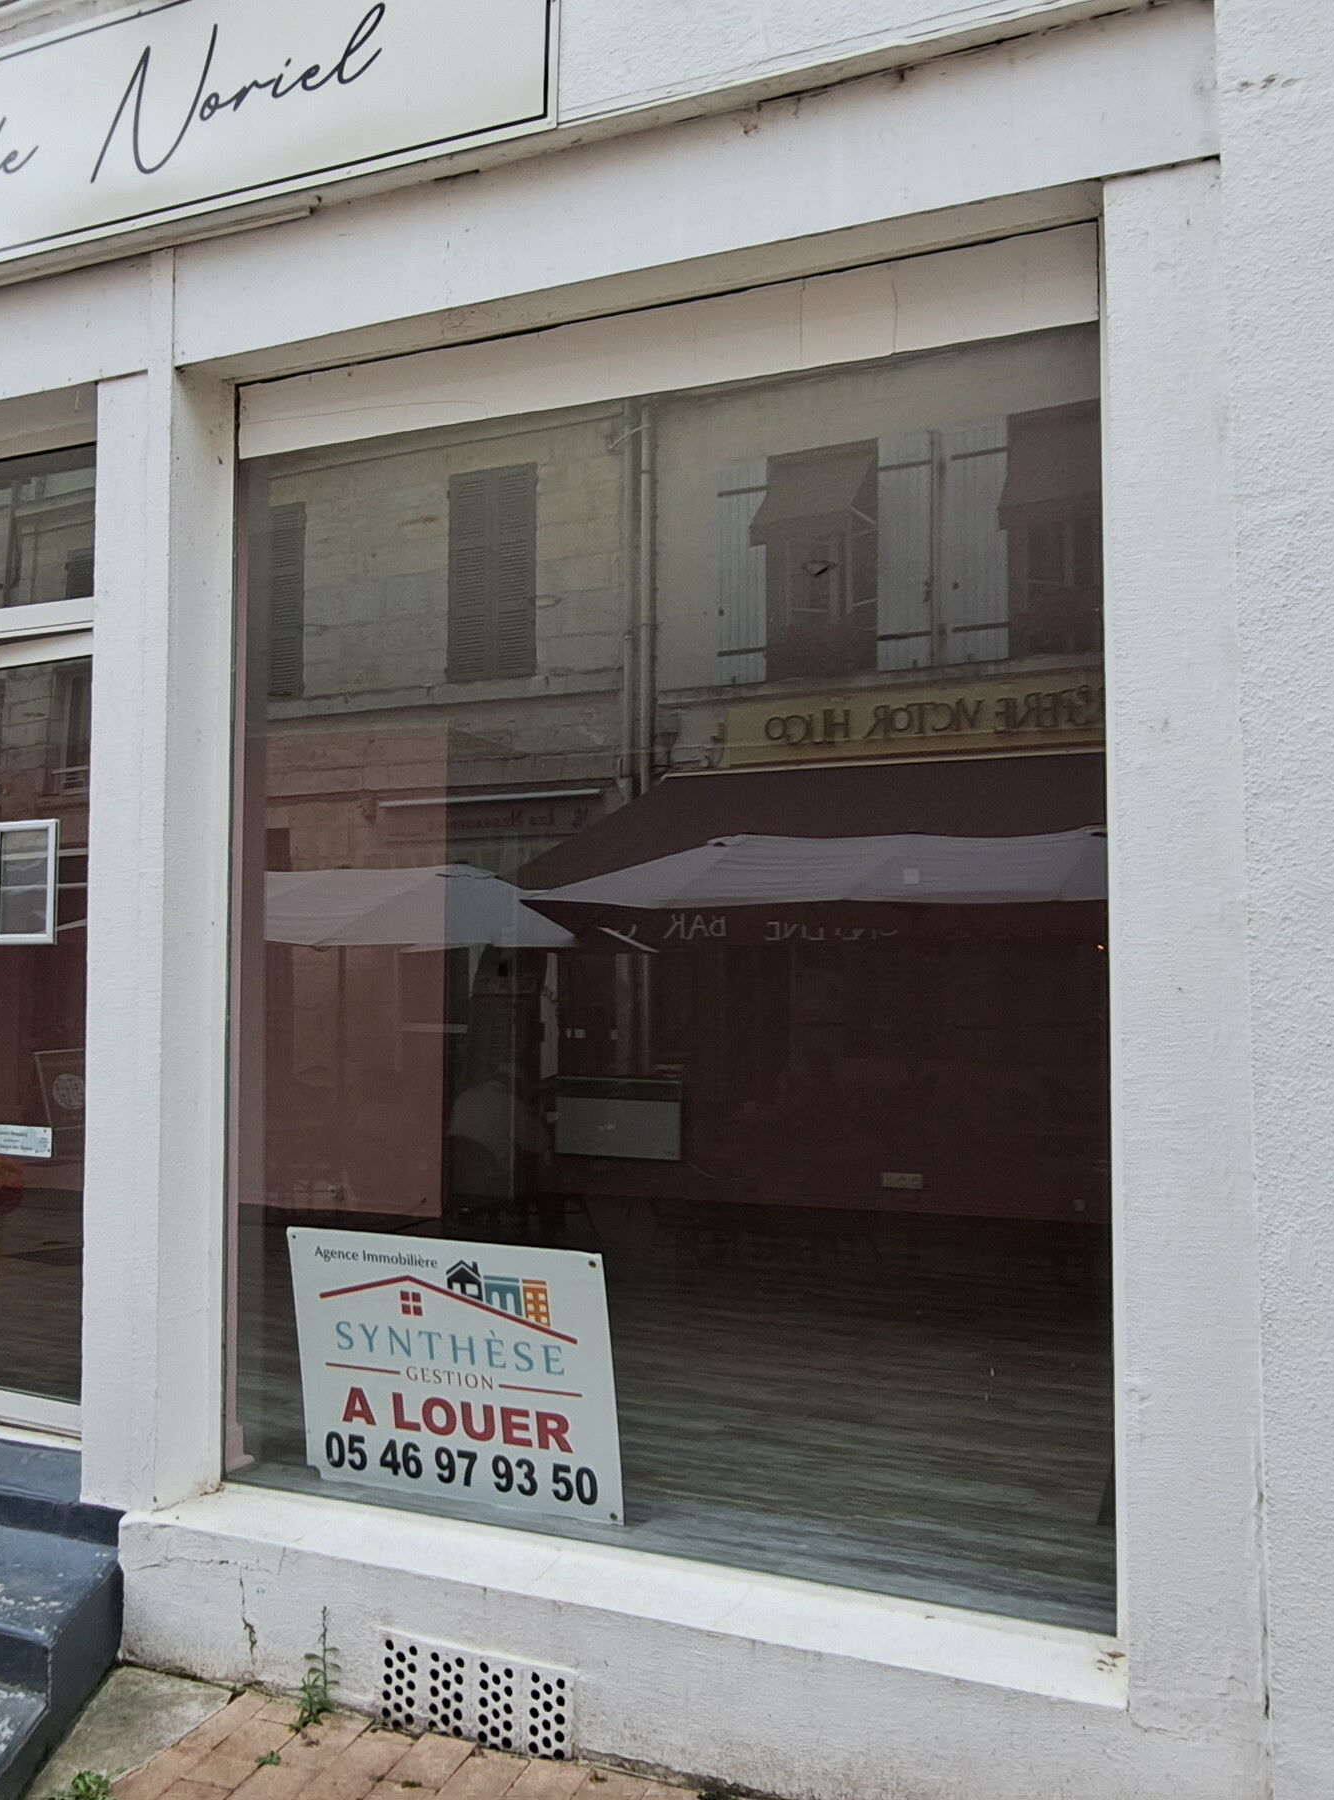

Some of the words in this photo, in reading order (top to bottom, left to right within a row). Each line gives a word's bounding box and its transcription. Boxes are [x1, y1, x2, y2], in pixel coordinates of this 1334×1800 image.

[89, 1, 385, 184] Noriel
[314, 1245, 359, 1262] Agence
[362, 1249, 438, 1269] Immobilière
[335, 1319, 566, 1376] SYNTHÈSE
[405, 1365, 495, 1391] GESTION
[342, 1386, 377, 1427] A
[392, 1391, 574, 1454] LOUER
[325, 1431, 368, 1471] 05
[379, 1439, 423, 1479] 46
[434, 1446, 478, 1487] 97
[491, 1454, 539, 1496] 93
[551, 1463, 599, 1506] 50
